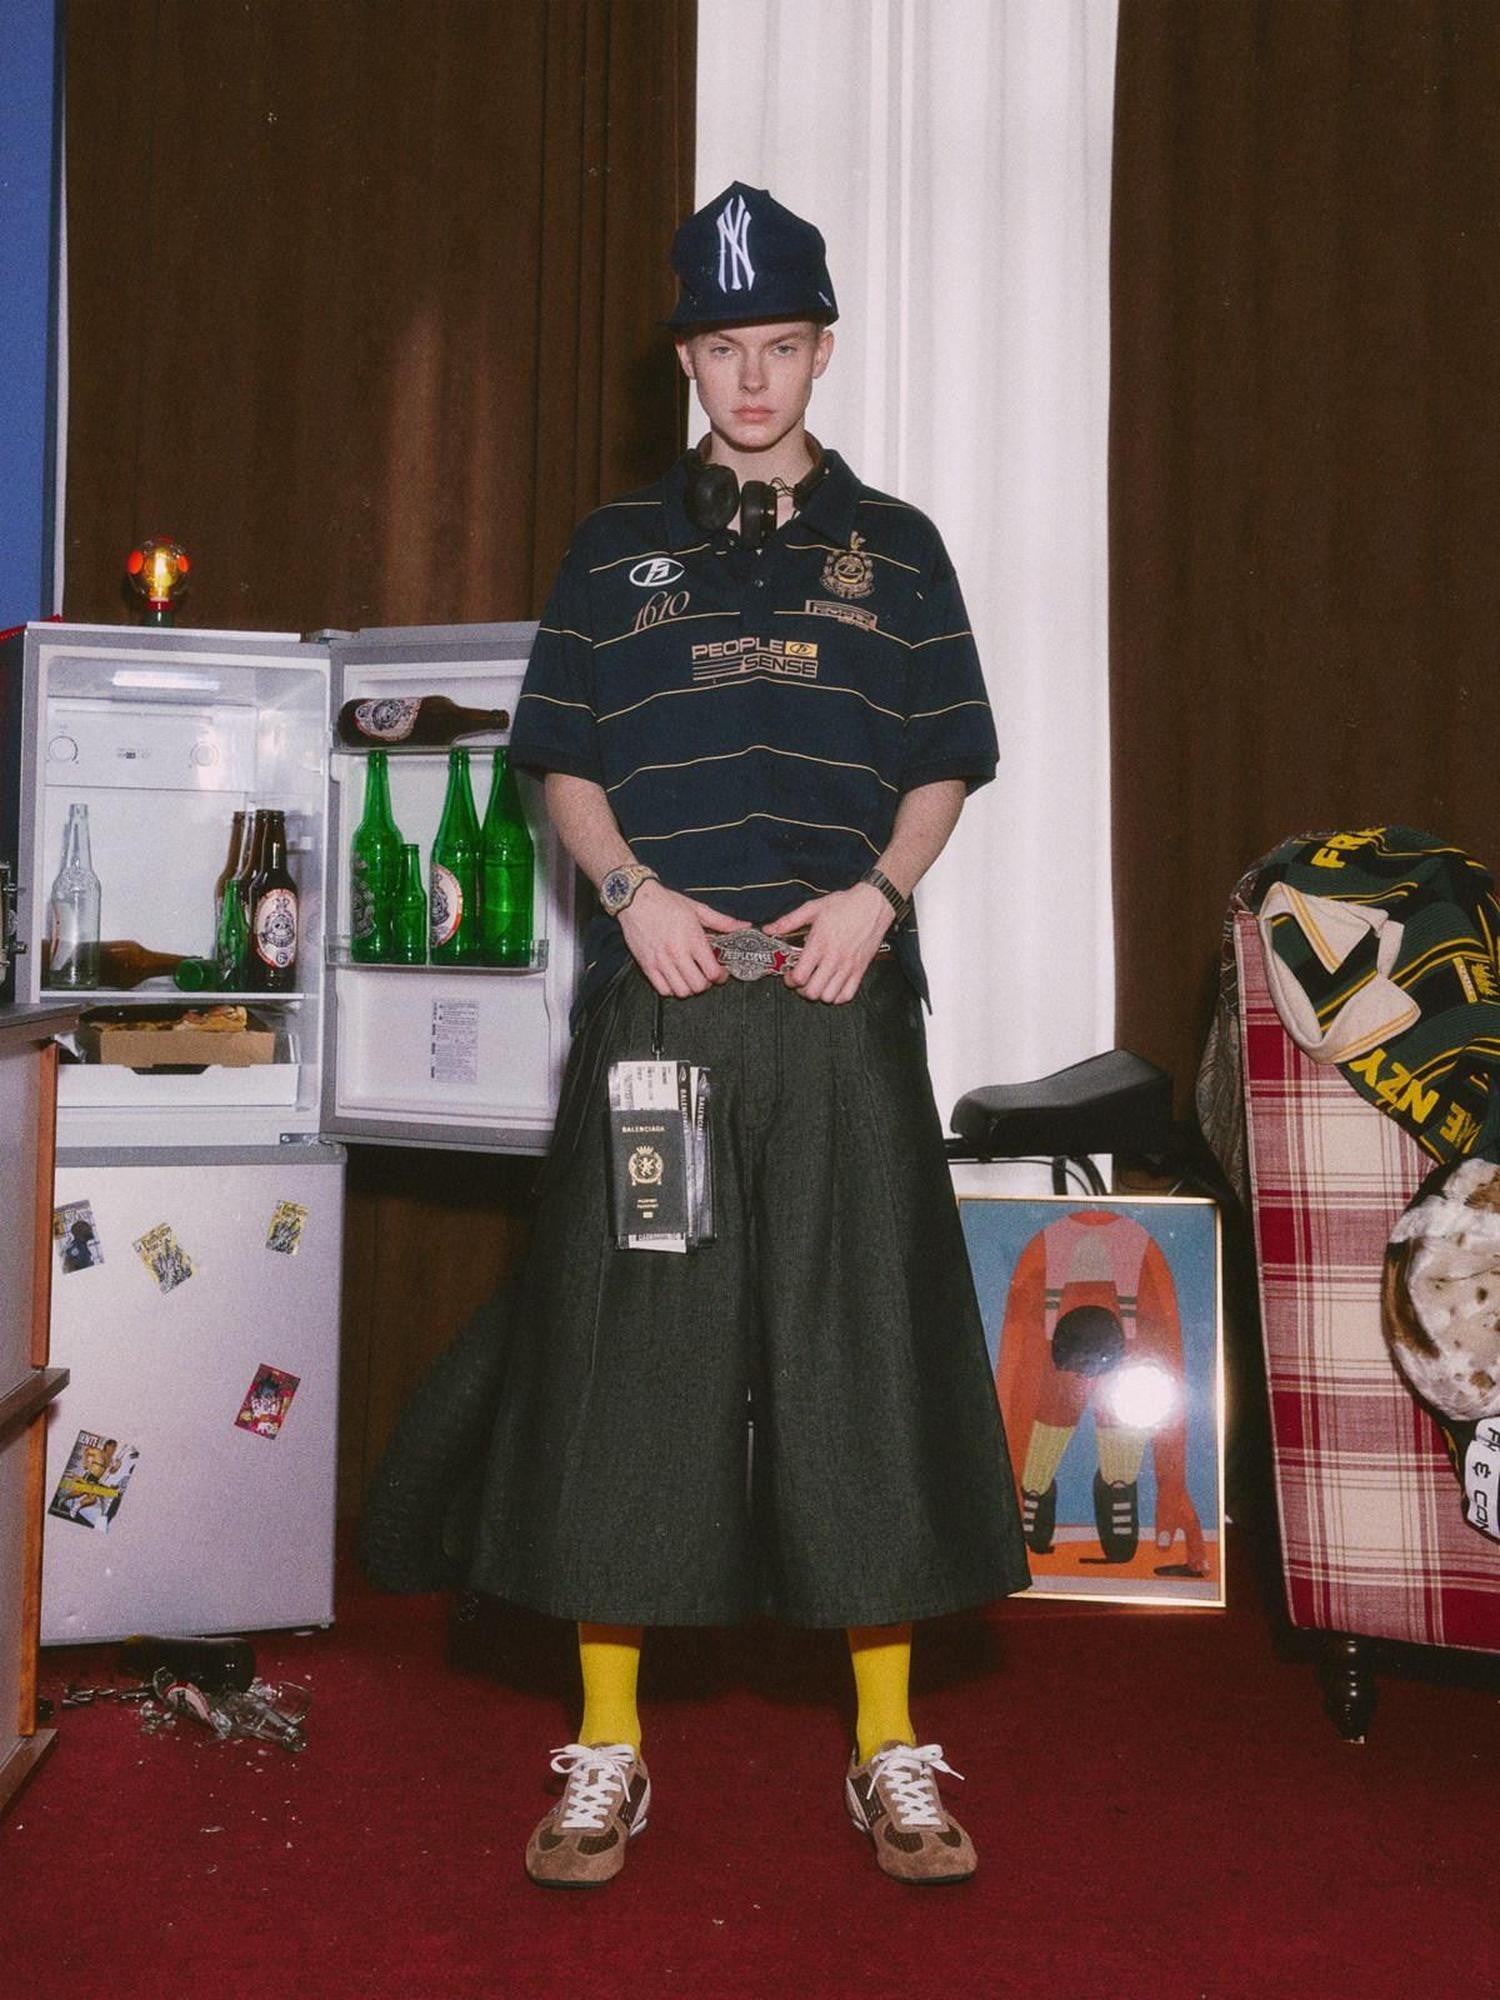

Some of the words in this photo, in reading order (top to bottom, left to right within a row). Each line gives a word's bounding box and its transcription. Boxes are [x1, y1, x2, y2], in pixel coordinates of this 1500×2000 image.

[716, 194, 755, 293] NY
[634, 591, 691, 632] 1610
[691, 637, 784, 660] PEOPLE
[743, 655, 817, 676] SENSE
